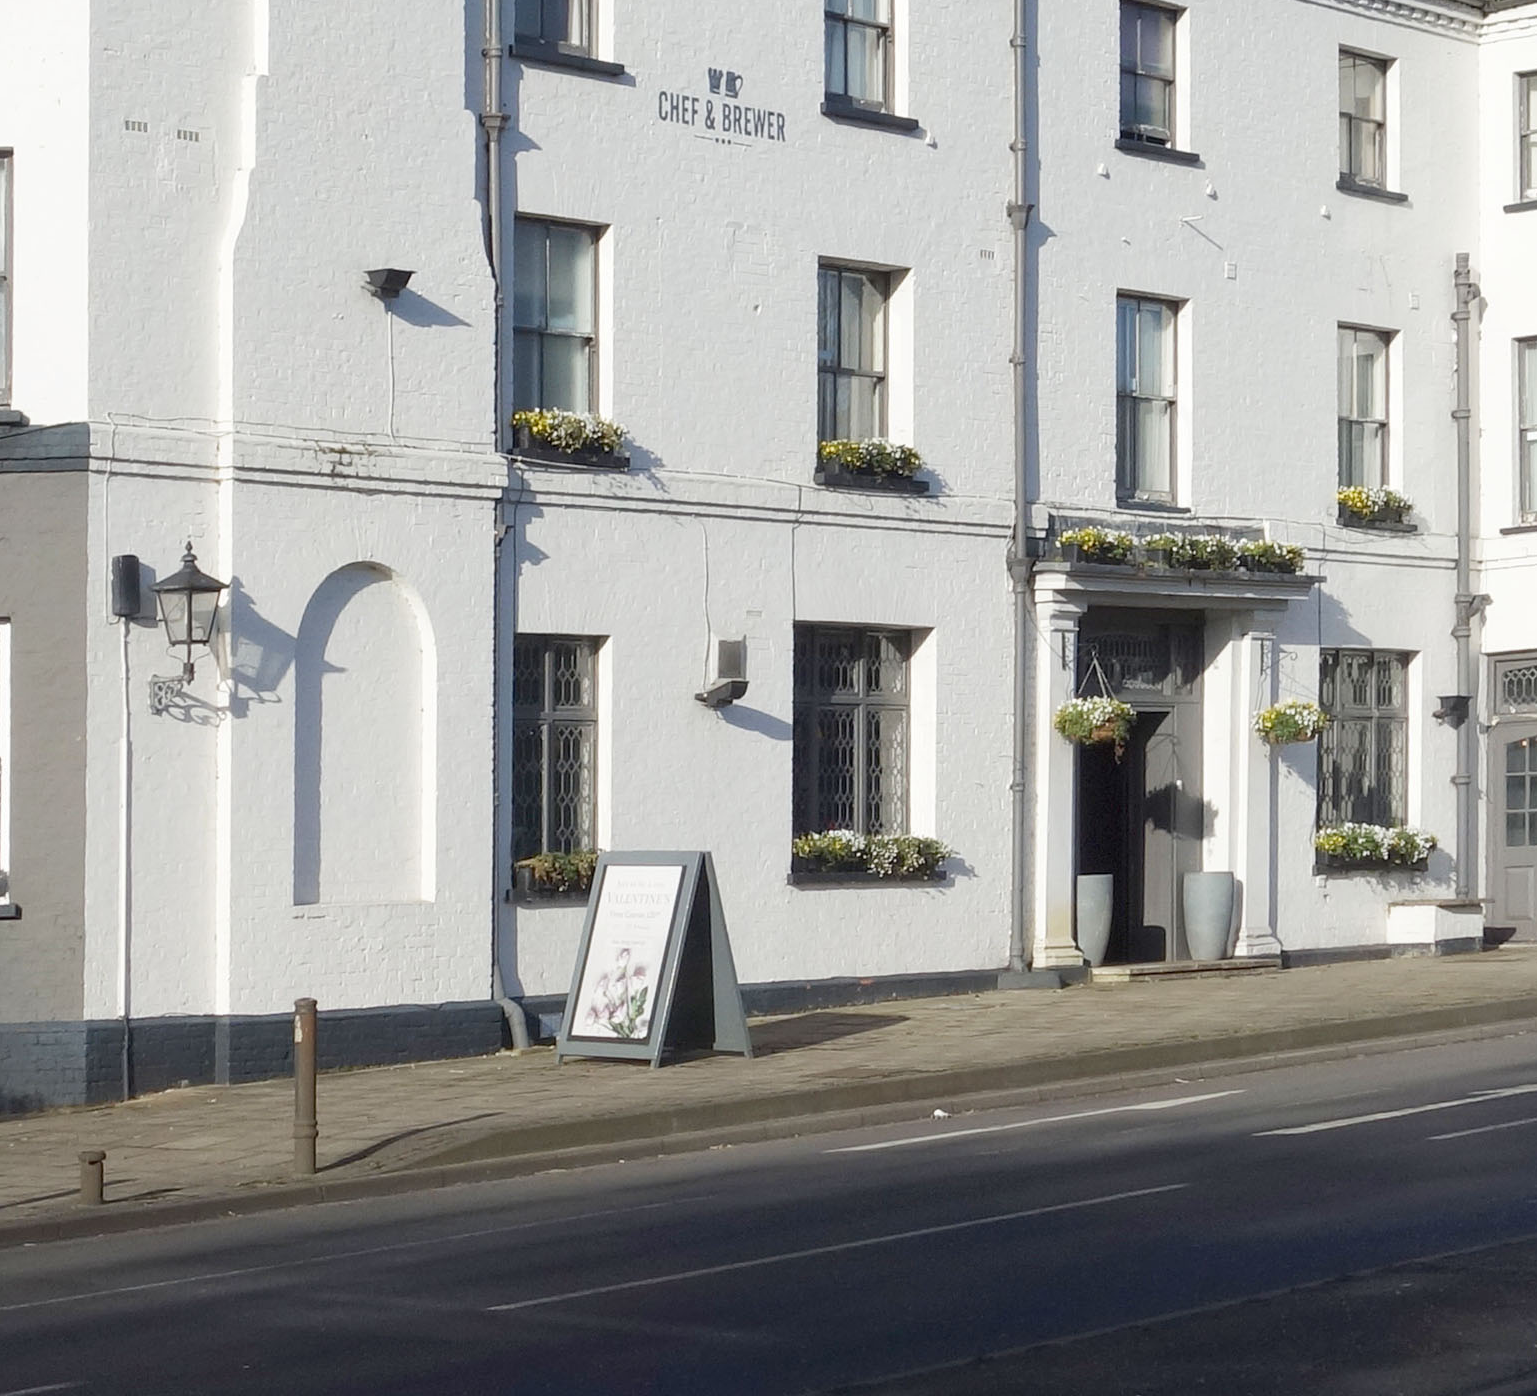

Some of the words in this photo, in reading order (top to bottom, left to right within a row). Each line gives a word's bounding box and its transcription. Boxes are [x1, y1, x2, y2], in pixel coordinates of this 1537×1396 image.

[658, 91, 700, 127] CHEF
[704, 99, 716, 130] &
[722, 103, 786, 142] BREWER
